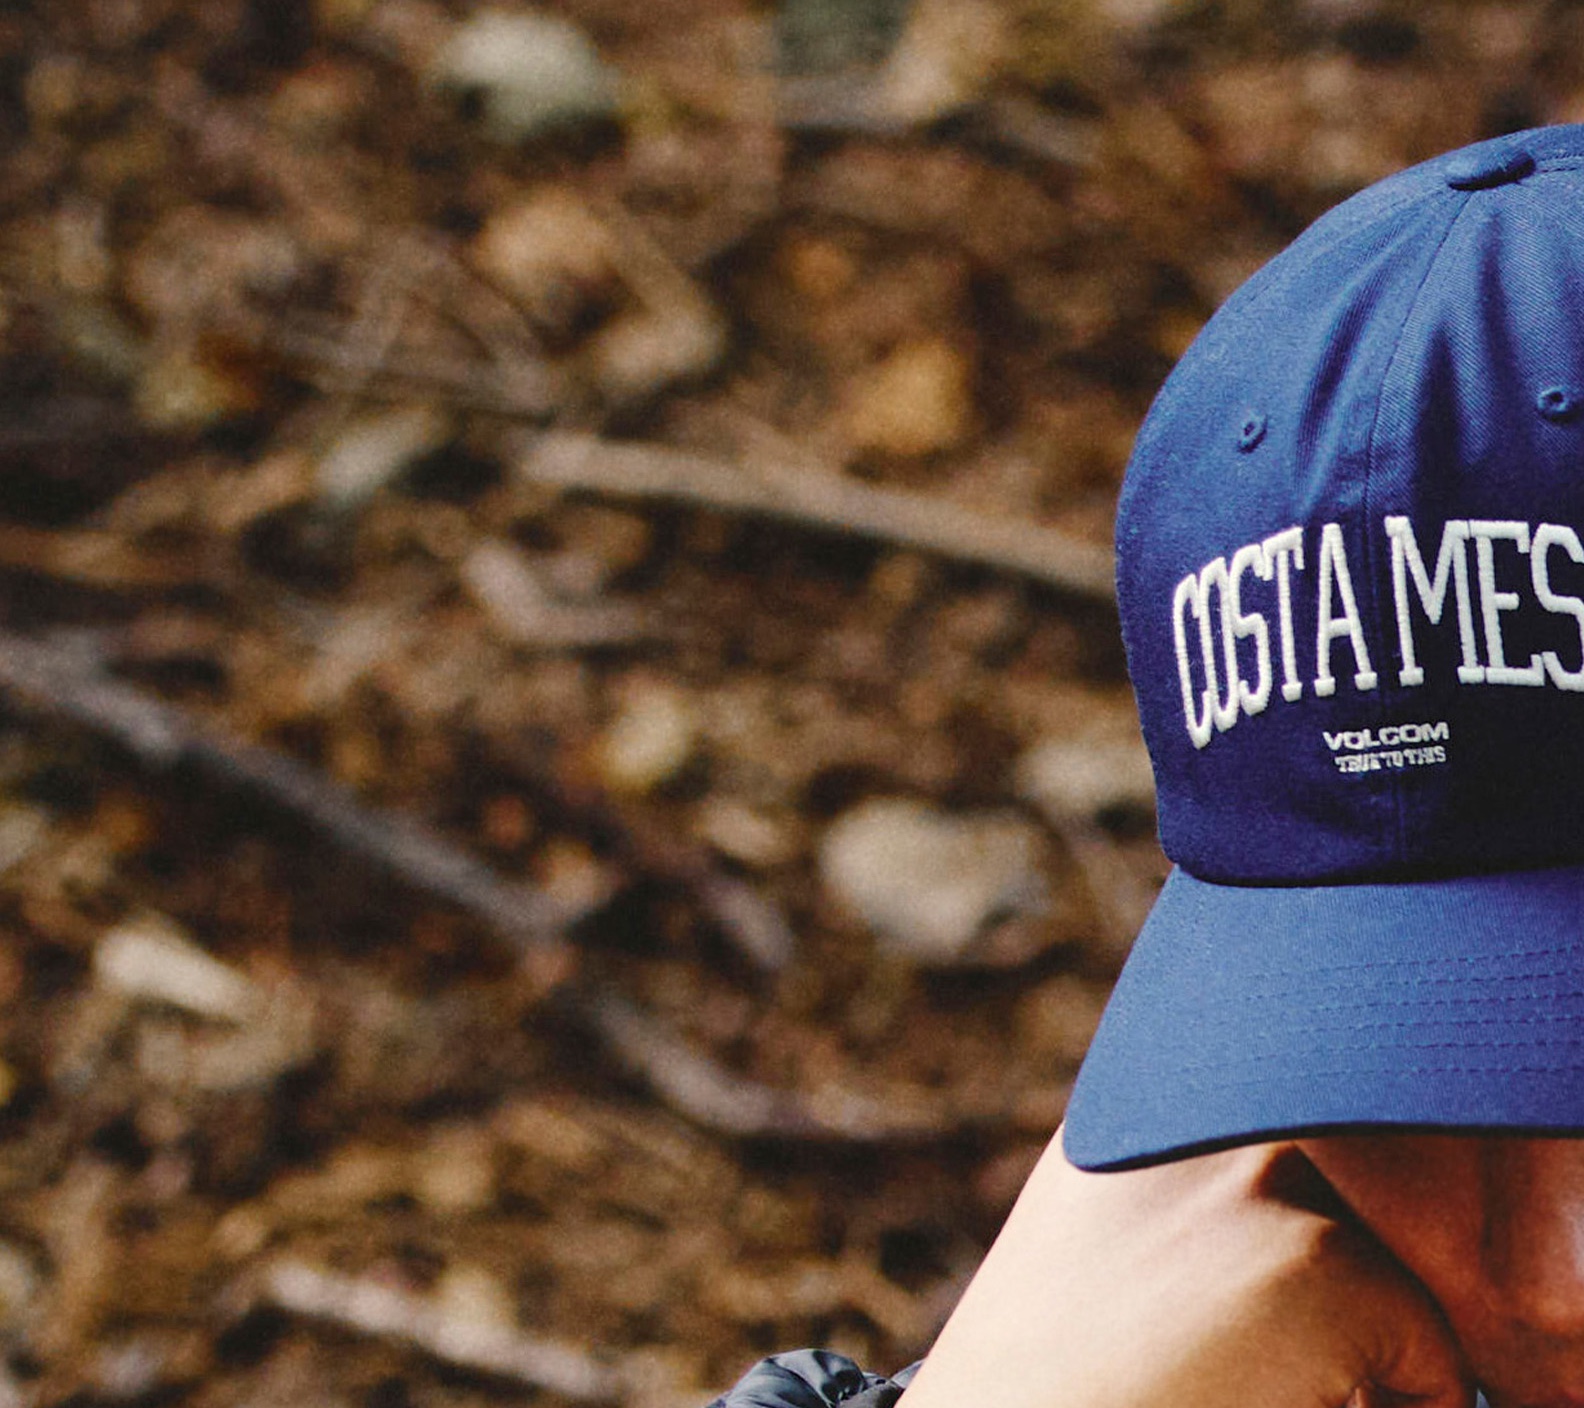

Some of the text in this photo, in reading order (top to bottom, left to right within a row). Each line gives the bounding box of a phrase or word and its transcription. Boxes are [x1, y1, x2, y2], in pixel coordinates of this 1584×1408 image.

[1173, 522, 1378, 750] COSTA
[1322, 721, 1450, 751] VOLCOM
[1403, 745, 1446, 766] THIS
